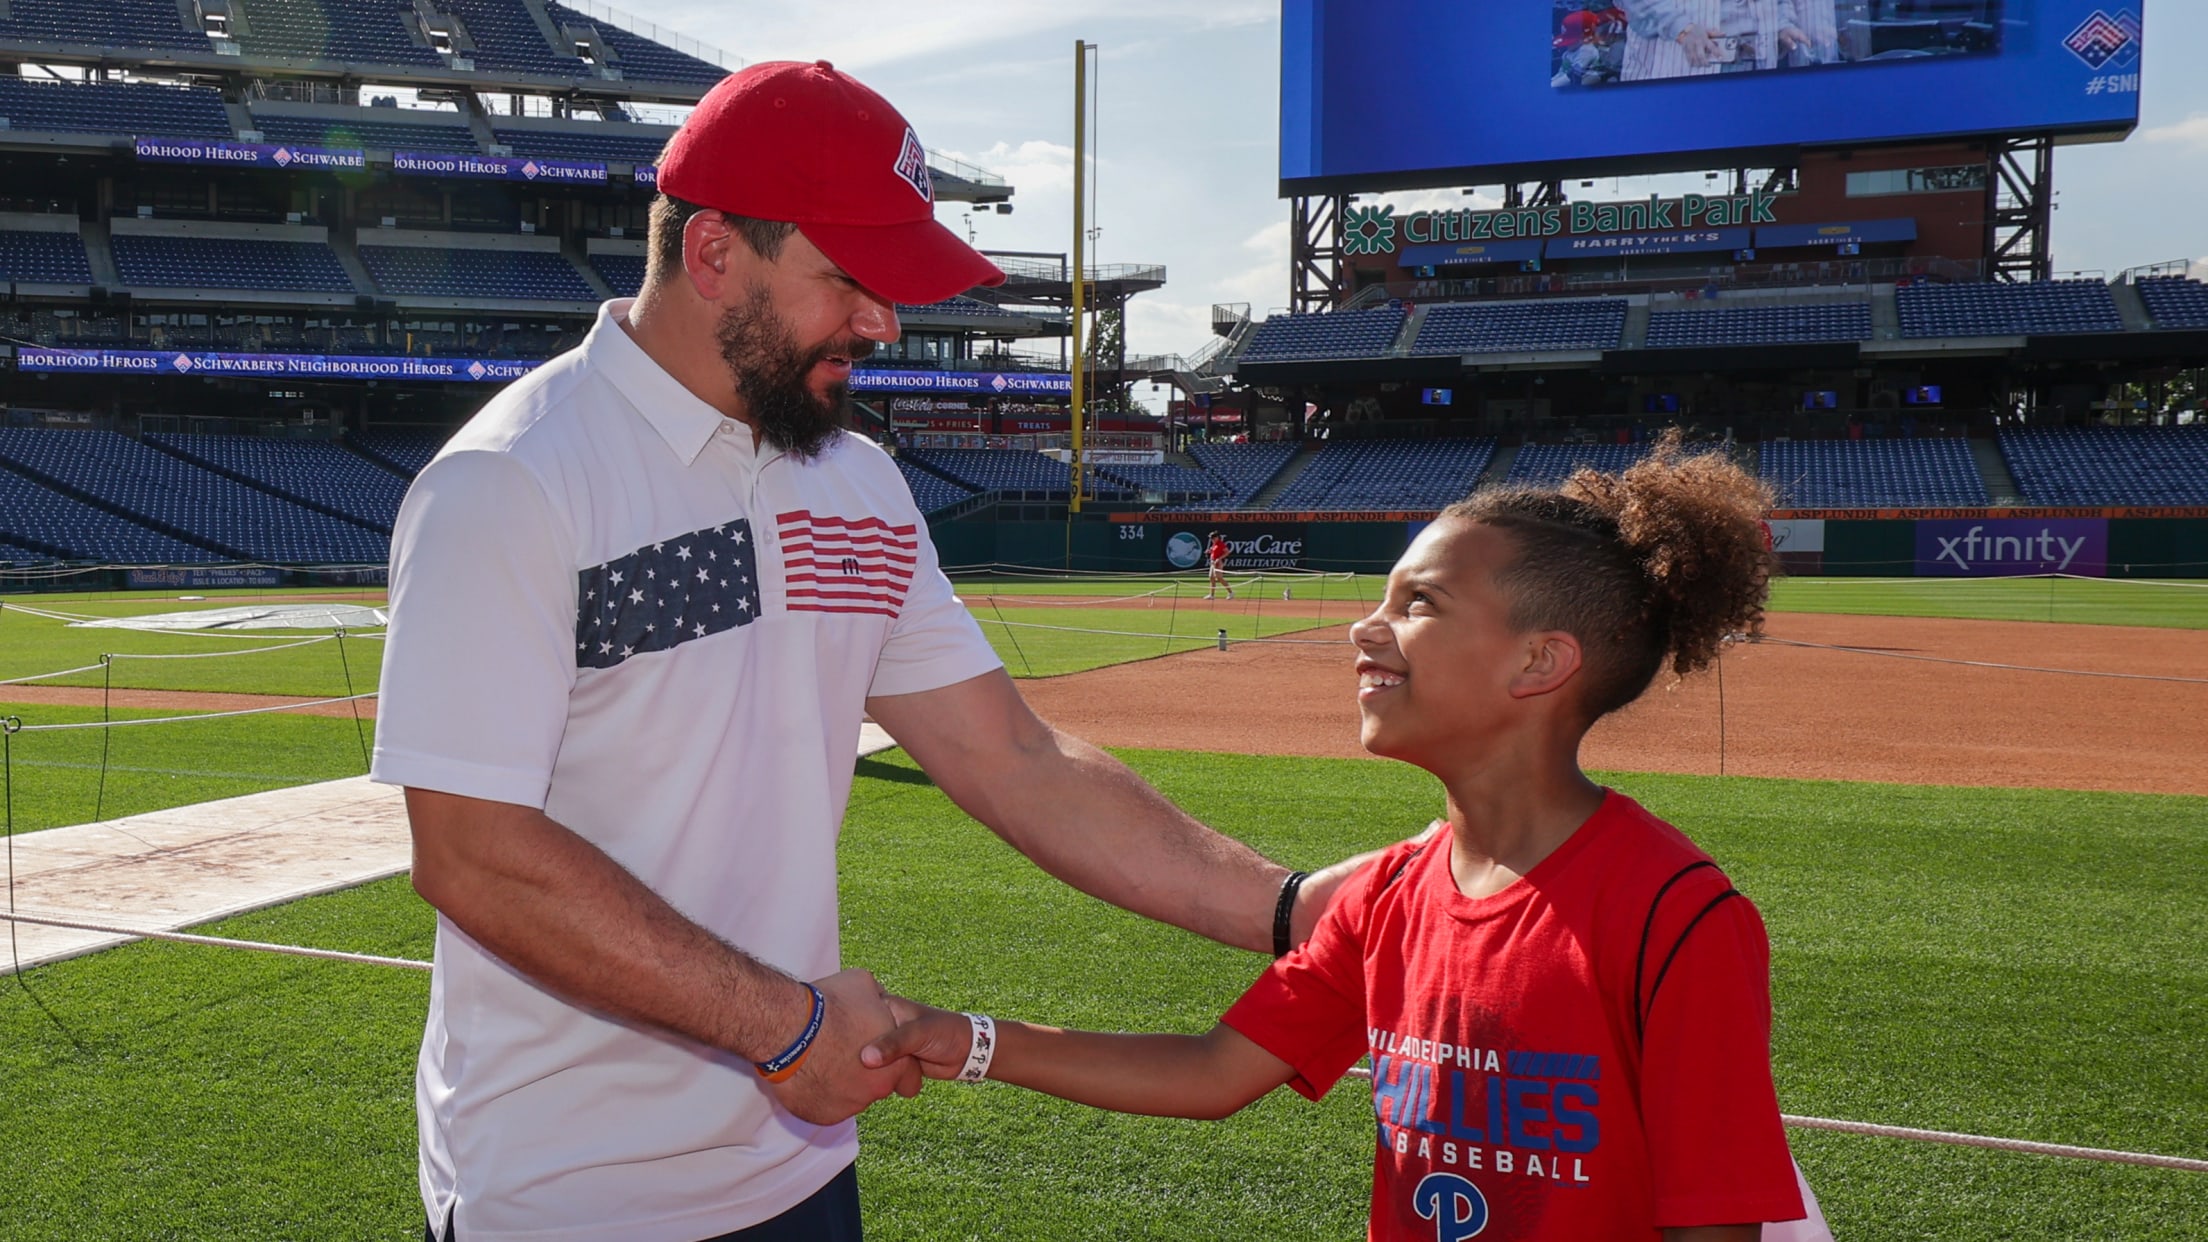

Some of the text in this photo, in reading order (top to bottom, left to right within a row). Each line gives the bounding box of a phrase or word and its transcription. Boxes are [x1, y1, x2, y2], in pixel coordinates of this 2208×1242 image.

[1404, 187, 1776, 243] Citizens Bank Park
[1573, 232, 1720, 248] HARRY THE K'S
[1018, 422, 1051, 430] TREATS
[1143, 513, 1212, 522] ASPLUNDH
[1227, 513, 1297, 522] ASPLUNDH
[1313, 512, 1386, 521] ASPLUNDH
[1790, 510, 1877, 520] ASPLUNDH
[1898, 509, 1988, 519] ASPLUNDH
[2008, 507, 2102, 518] ASPLUNDH
[1119, 525, 1144, 540] 334
[1936, 526, 2086, 570] xfinity
[1205, 558, 1298, 567] RABILITATION
[1371, 1054, 1600, 1154] HILLIES
[1396, 1131, 1590, 1182] BASEBALL
[1413, 1172, 1489, 1242] P
